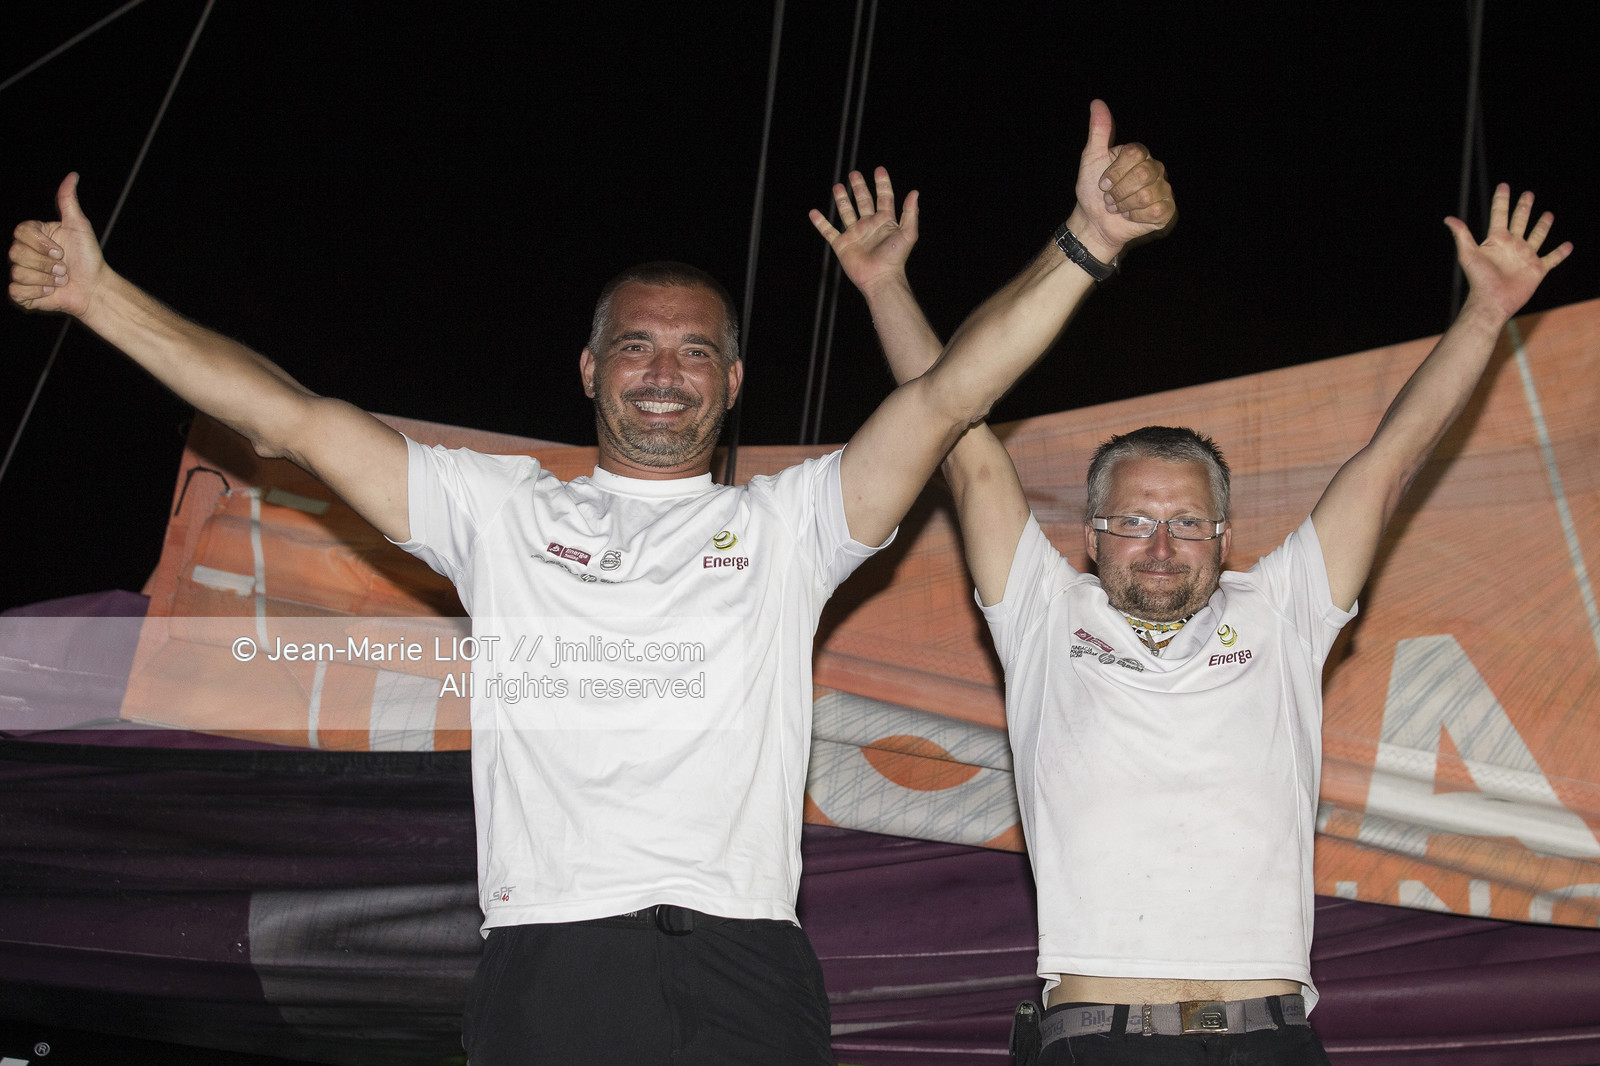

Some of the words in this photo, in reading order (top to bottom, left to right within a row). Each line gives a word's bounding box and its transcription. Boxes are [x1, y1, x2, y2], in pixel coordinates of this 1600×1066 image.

[703, 555, 749, 570] Energa
[1208, 648, 1253, 667] Energa
[489, 886, 516, 902] SPF
